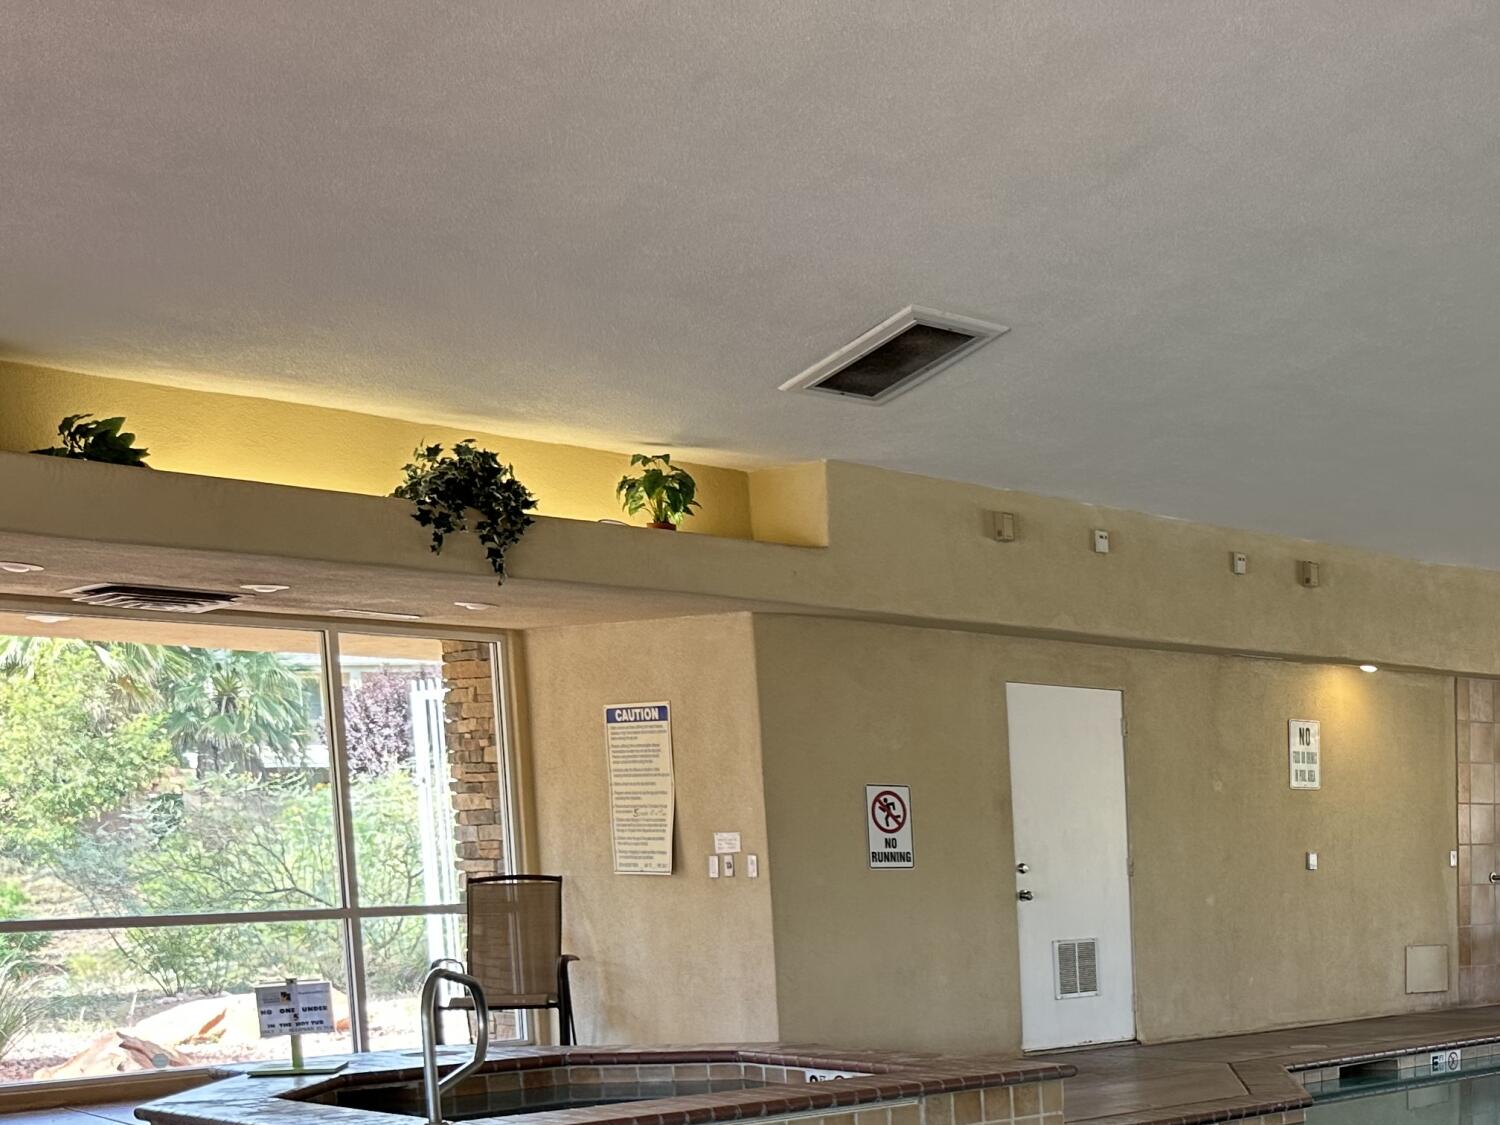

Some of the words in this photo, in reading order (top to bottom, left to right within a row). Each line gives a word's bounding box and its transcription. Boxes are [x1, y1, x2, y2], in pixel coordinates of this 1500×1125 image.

[615, 708, 659, 721] CAUTION
[1299, 727, 1311, 746] NO
[884, 837, 897, 849] NO
[871, 852, 912, 863] RUNNING
